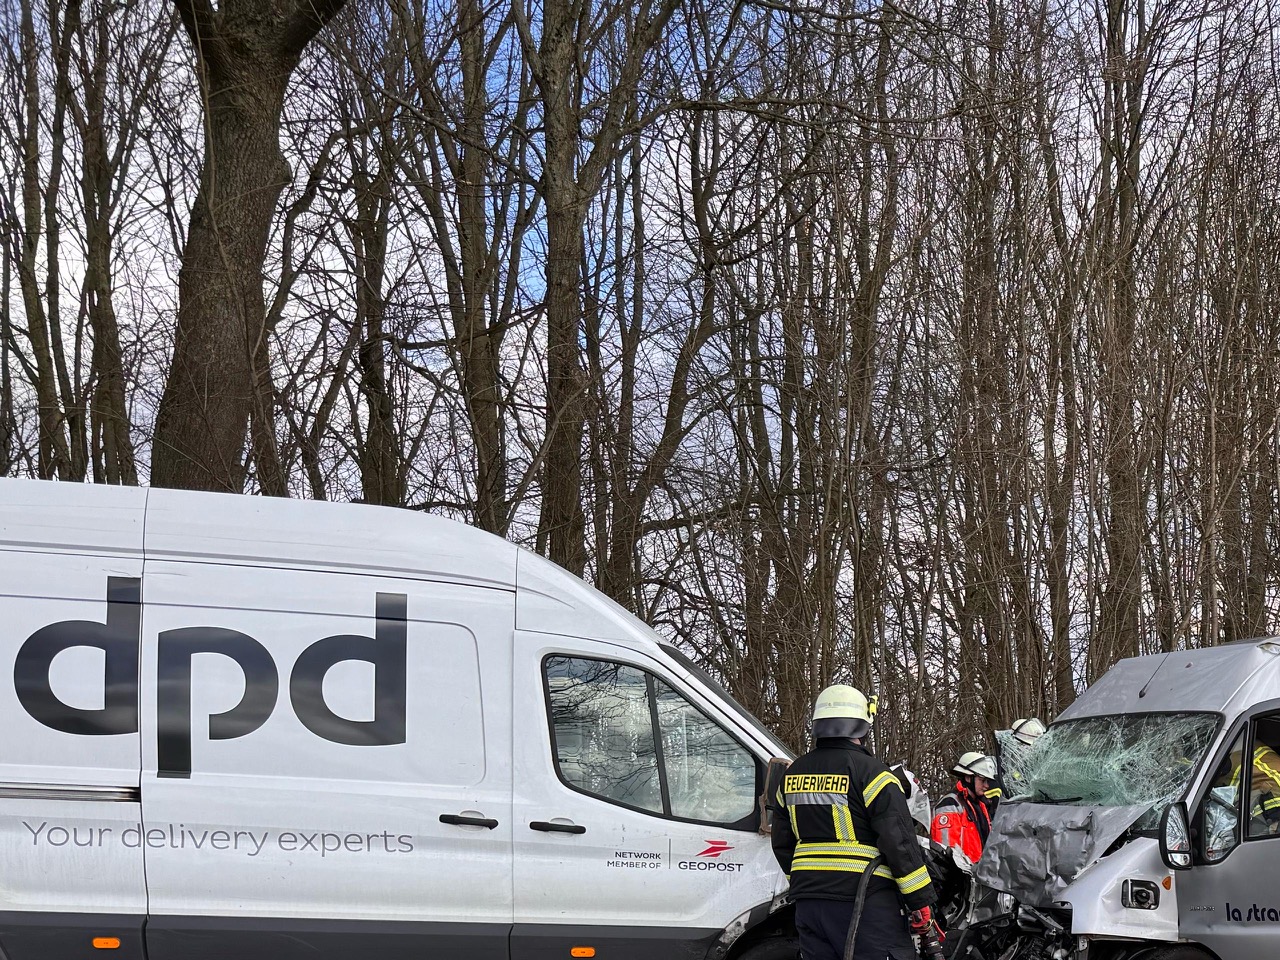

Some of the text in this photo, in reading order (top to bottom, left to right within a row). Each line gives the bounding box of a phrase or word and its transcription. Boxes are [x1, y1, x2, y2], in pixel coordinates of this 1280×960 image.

[14, 576, 408, 779] dpd
[786, 776, 848, 792] FEUERWEHR
[22, 820, 415, 858] Your delivery experts
[614, 851, 662, 860] NETWORK
[606, 860, 661, 870] MEMBER OF
[678, 861, 744, 872] GEOPOST
[1225, 902, 1243, 922] la
